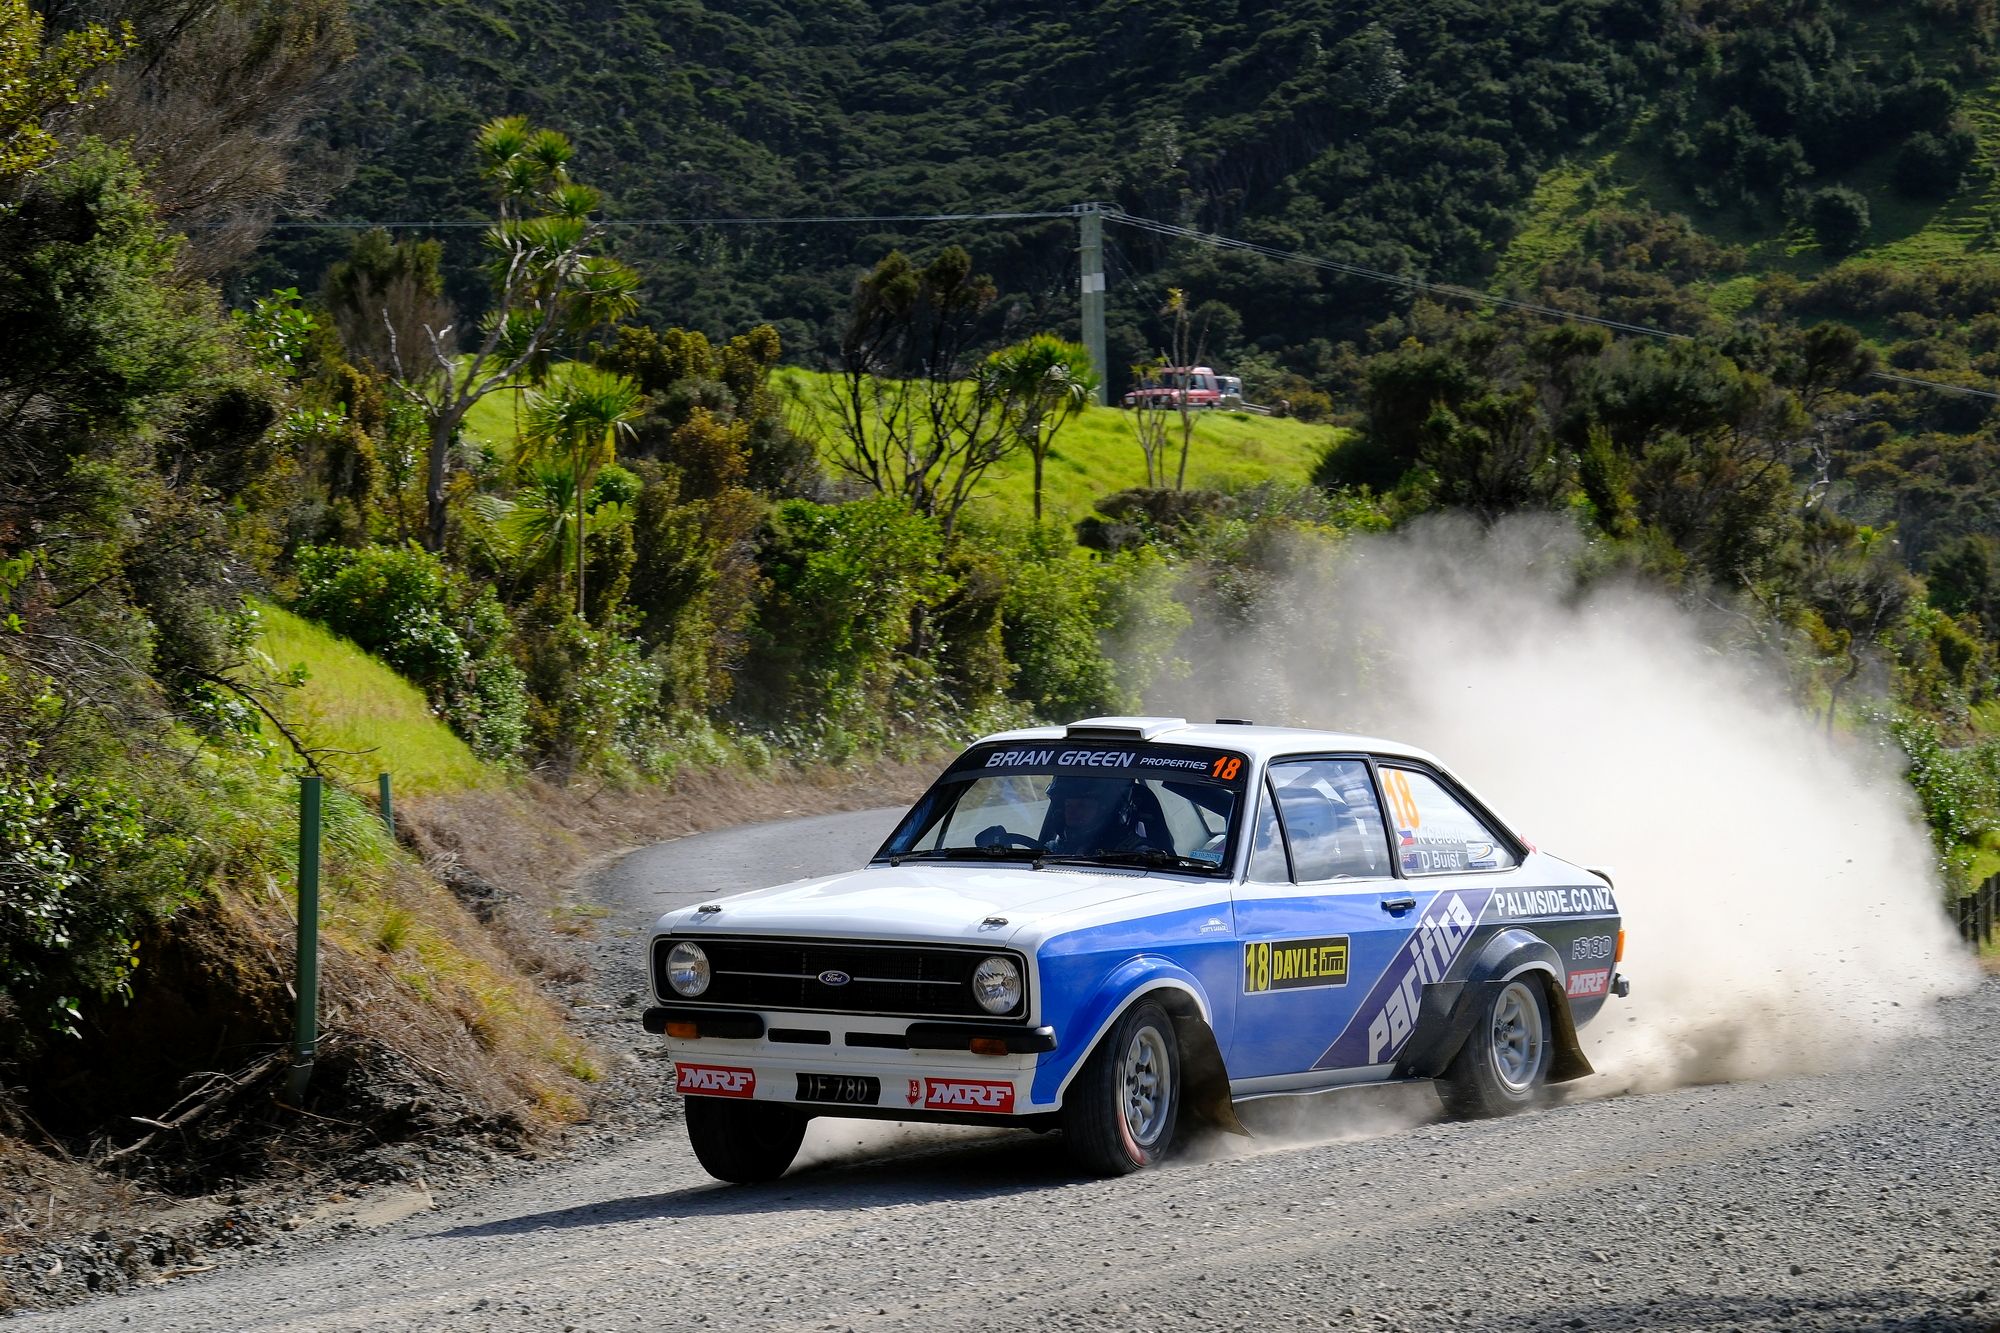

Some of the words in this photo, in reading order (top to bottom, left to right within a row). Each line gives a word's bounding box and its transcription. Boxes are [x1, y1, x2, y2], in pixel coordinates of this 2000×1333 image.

[984, 751, 1055, 768] BRIAN
[1057, 751, 1136, 768] GREEN
[1139, 757, 1209, 770] PROPERTIES
[1211, 756, 1242, 781] 18
[1383, 768, 1421, 829] 18
[1421, 851, 1429, 869] D
[1432, 849, 1461, 868] Buist
[1495, 887, 1614, 916] PALMSIDE.CO.NZ
[825, 972, 843, 982] Ford
[1247, 943, 1269, 992] 18
[1273, 948, 1317, 980] DAYLE
[1568, 972, 1609, 995] MRF
[679, 1067, 754, 1093] MRF
[928, 1082, 1012, 1107] MRF
